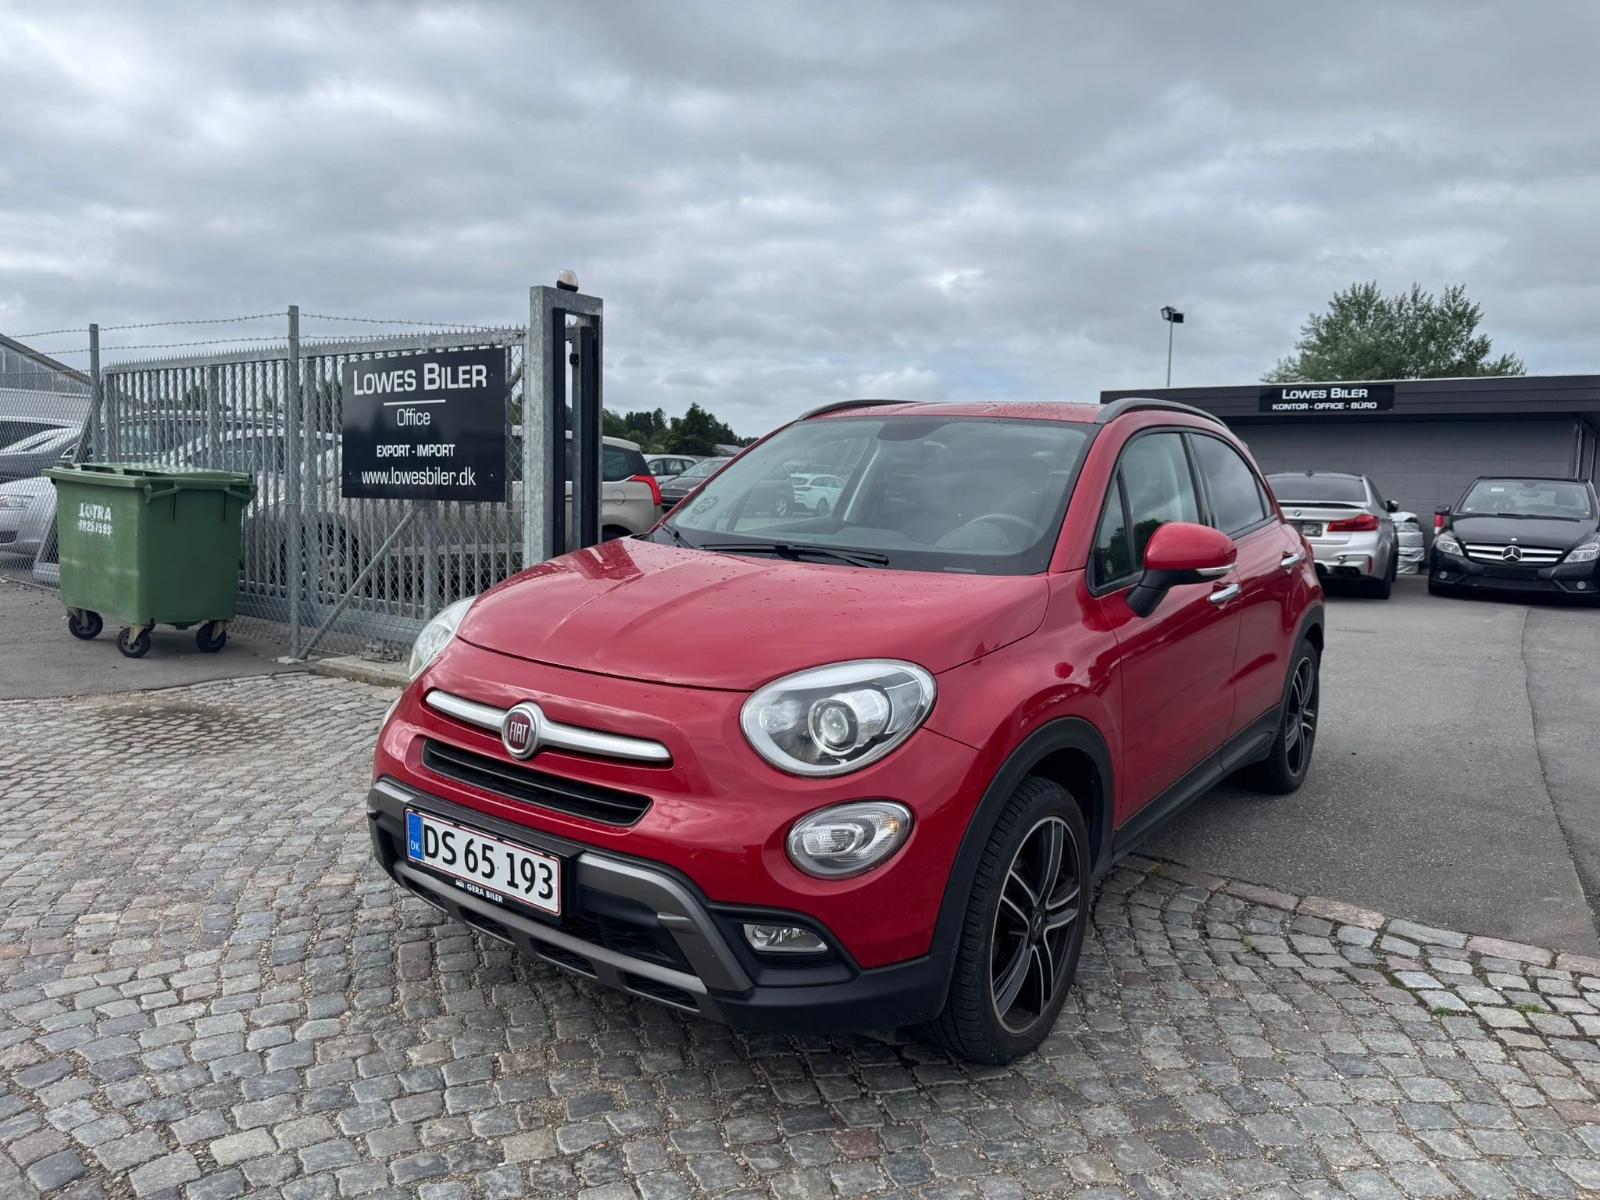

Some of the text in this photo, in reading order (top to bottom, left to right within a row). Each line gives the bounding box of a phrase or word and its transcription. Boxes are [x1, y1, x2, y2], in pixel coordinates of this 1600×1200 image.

[353, 362, 487, 396] LOWES BILER
[1282, 388, 1368, 399] LOWES BILER
[1271, 403, 1309, 411] KONTOR
[1314, 402, 1345, 410] OFFICE
[1350, 401, 1377, 409] BÜRO
[396, 408, 431, 426] Office
[376, 445, 411, 458] EXPORT
[417, 444, 456, 457] IMPORT
[361, 466, 477, 486] www.lowesbiler.dk
[509, 721, 529, 744] FIAT
[410, 840, 421, 853] DK
[423, 824, 554, 900] DS 65 193
[466, 883, 504, 903] GERA BILER
